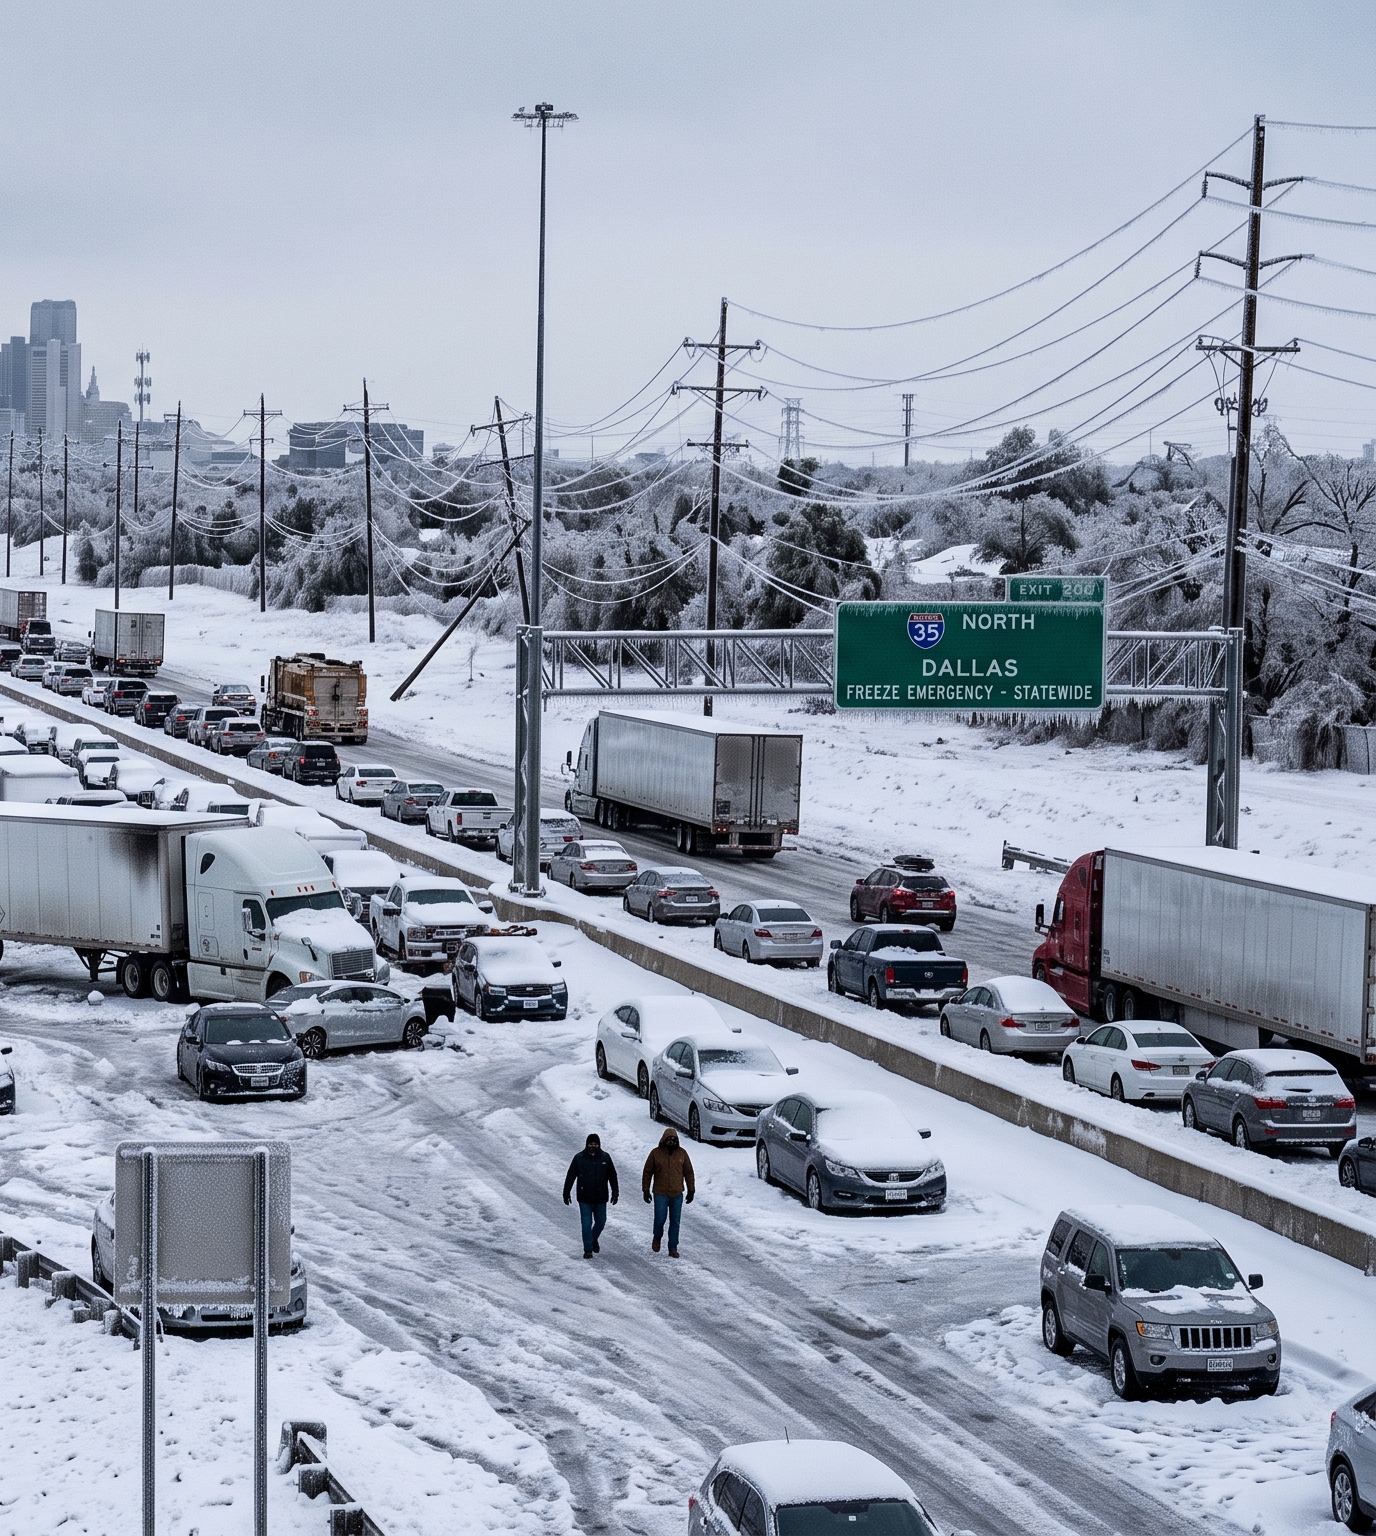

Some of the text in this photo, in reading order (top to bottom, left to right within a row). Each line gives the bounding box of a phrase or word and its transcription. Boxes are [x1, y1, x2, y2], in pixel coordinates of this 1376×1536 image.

[1019, 584, 1052, 595] EXIT
[962, 613, 1035, 630] NORTH
[913, 623, 939, 641] 35
[922, 658, 1018, 677] DALLAS
[846, 684, 900, 700] FREEZE
[907, 684, 994, 700] EMERGENCY
[1013, 685, 1093, 700] STATEWIDE
